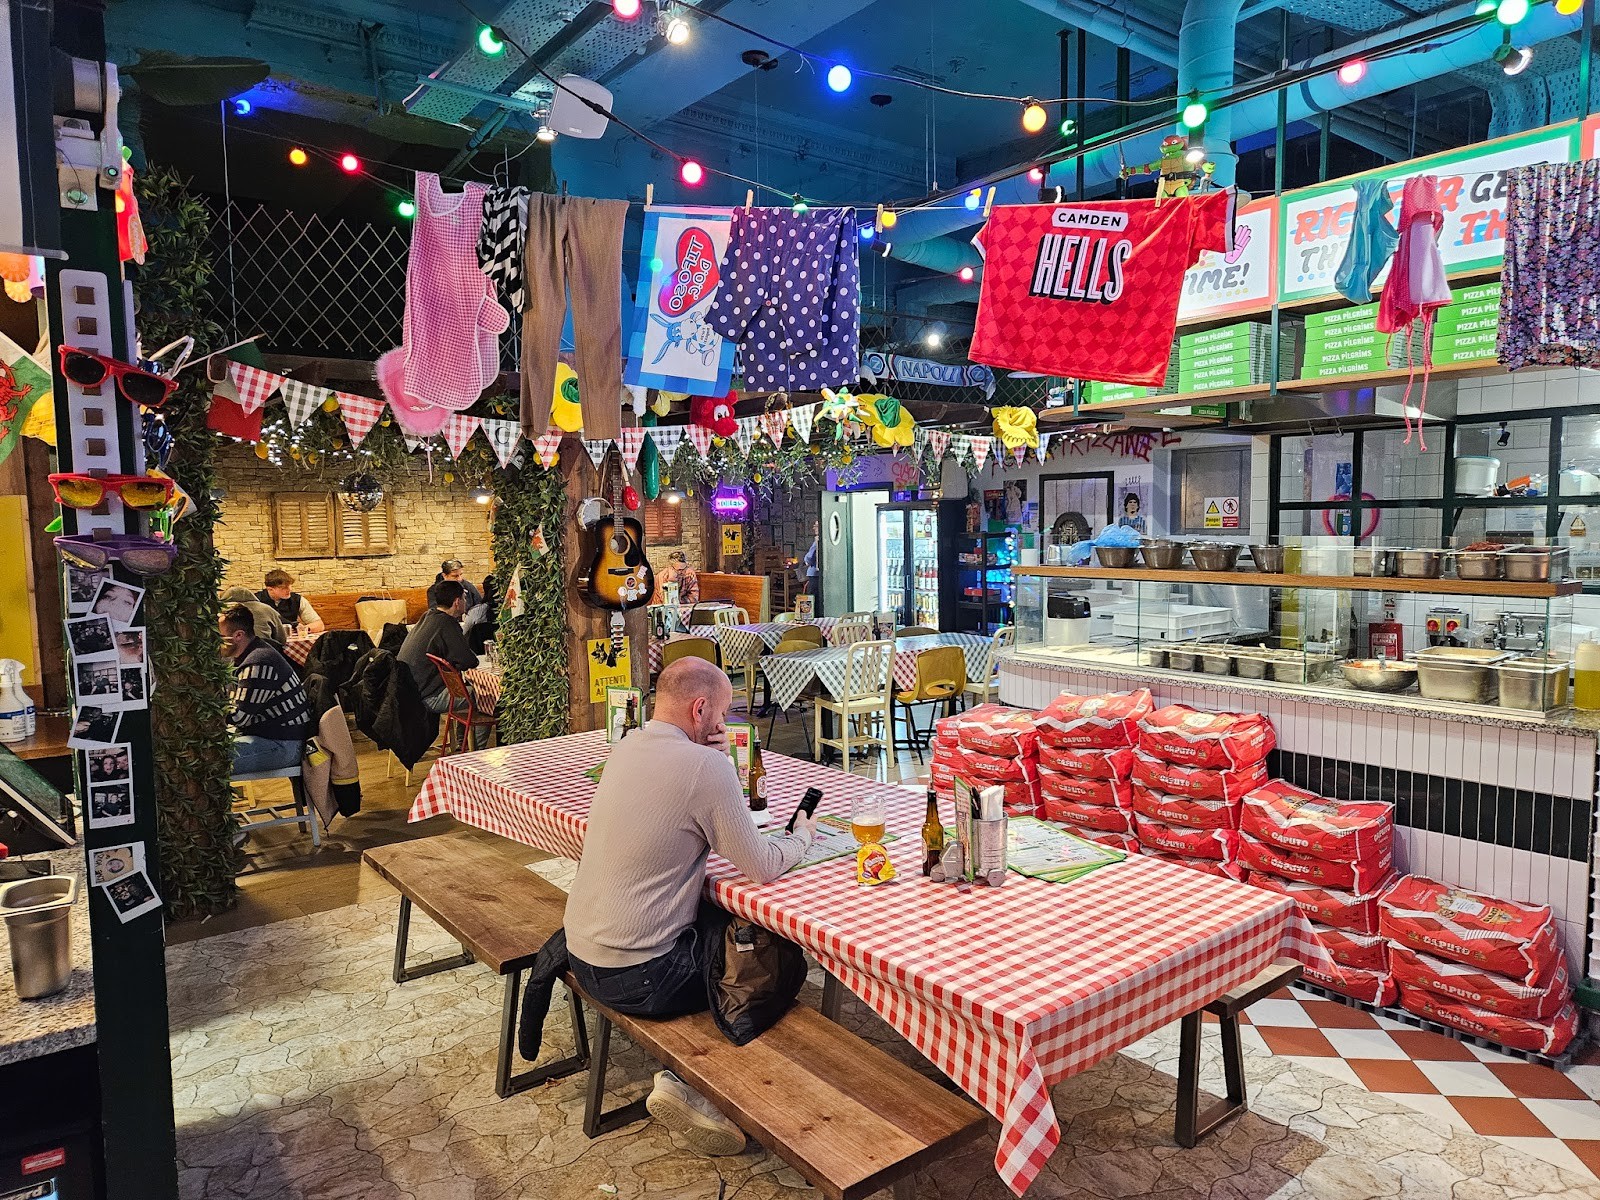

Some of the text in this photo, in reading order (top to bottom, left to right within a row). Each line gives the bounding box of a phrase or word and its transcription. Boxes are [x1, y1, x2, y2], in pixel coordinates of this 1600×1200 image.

[1470, 170, 1507, 203] GE
[1057, 211, 1122, 227] CAMDEN
[668, 235, 704, 311] TIFOSO
[1030, 233, 1132, 304] HELLS
[688, 258, 712, 300] D.O.C.
[1464, 290, 1485, 300] PIZZA
[1462, 307, 1483, 316] PIZZA
[1324, 314, 1341, 323] PIZZA
[1324, 328, 1342, 336] PIZZA
[1456, 322, 1478, 331] PIZZA
[1324, 341, 1342, 349] PIZZA
[1455, 336, 1476, 346] PIZZA
[1322, 354, 1340, 362] PIZZA
[1454, 351, 1475, 360] PIZZA
[902, 360, 956, 382] NAPOLI
[1320, 368, 1337, 376] PIZZA
[595, 675, 626, 688] ATTENTI
[1062, 736, 1092, 744] CAPUTO
[1164, 744, 1196, 756] CAPUTO
[1056, 758, 1082, 768] CAPUTO
[1160, 776, 1190, 787] CAPUTO
[1058, 784, 1086, 794] CAPUTO
[1062, 810, 1090, 822] CAPUTO
[1157, 809, 1188, 820] CAPUTO
[1156, 837, 1186, 849] CAPUTO
[1271, 831, 1310, 848] CAPUTO
[1271, 858, 1310, 874] CAPUTO
[1423, 935, 1470, 956] CAPUTO
[1432, 980, 1482, 1001] CAPUTO
[1437, 1009, 1484, 1032] CAPUTO
